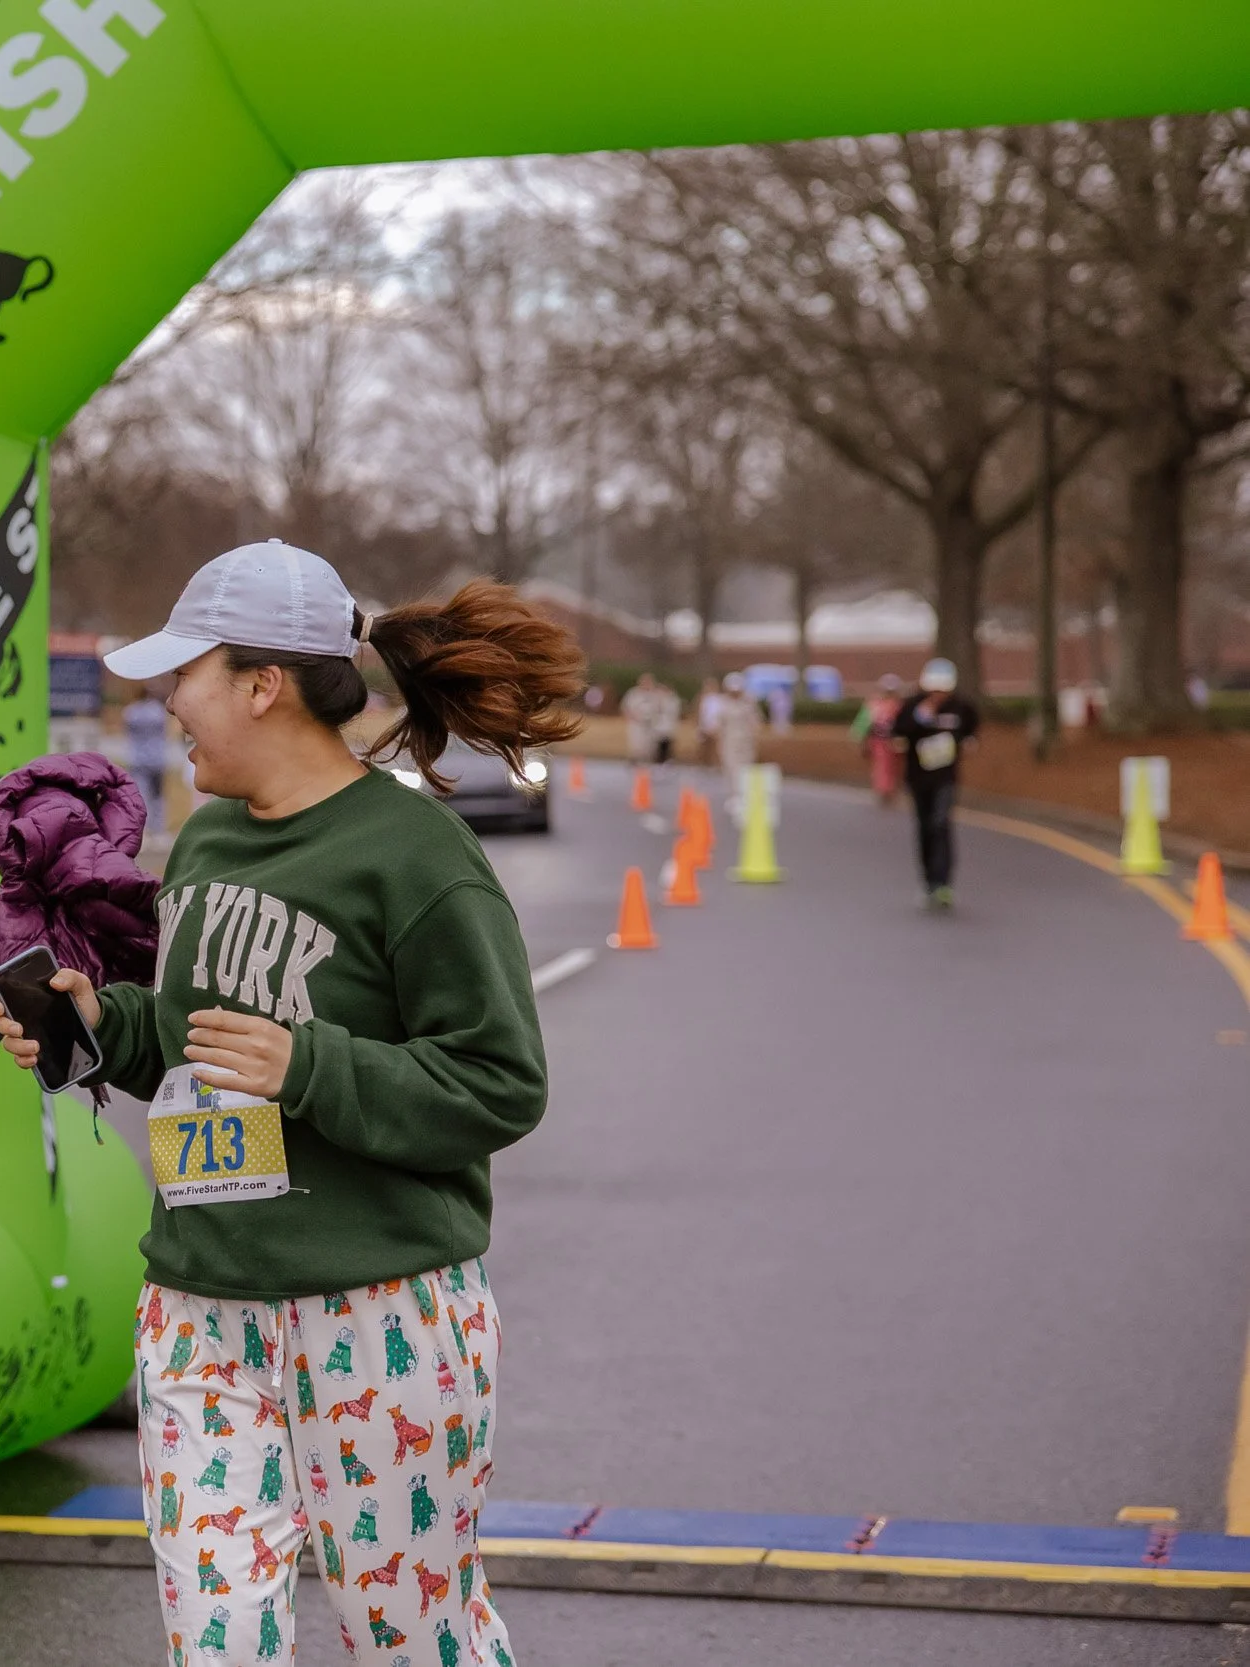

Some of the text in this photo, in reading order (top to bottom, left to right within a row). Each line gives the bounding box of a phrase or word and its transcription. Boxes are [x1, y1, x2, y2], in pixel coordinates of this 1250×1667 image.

[192, 882, 337, 1024] YORK
[177, 1116, 245, 1175] 713
[166, 1181, 267, 1197] www.FiveStarNTP.com
